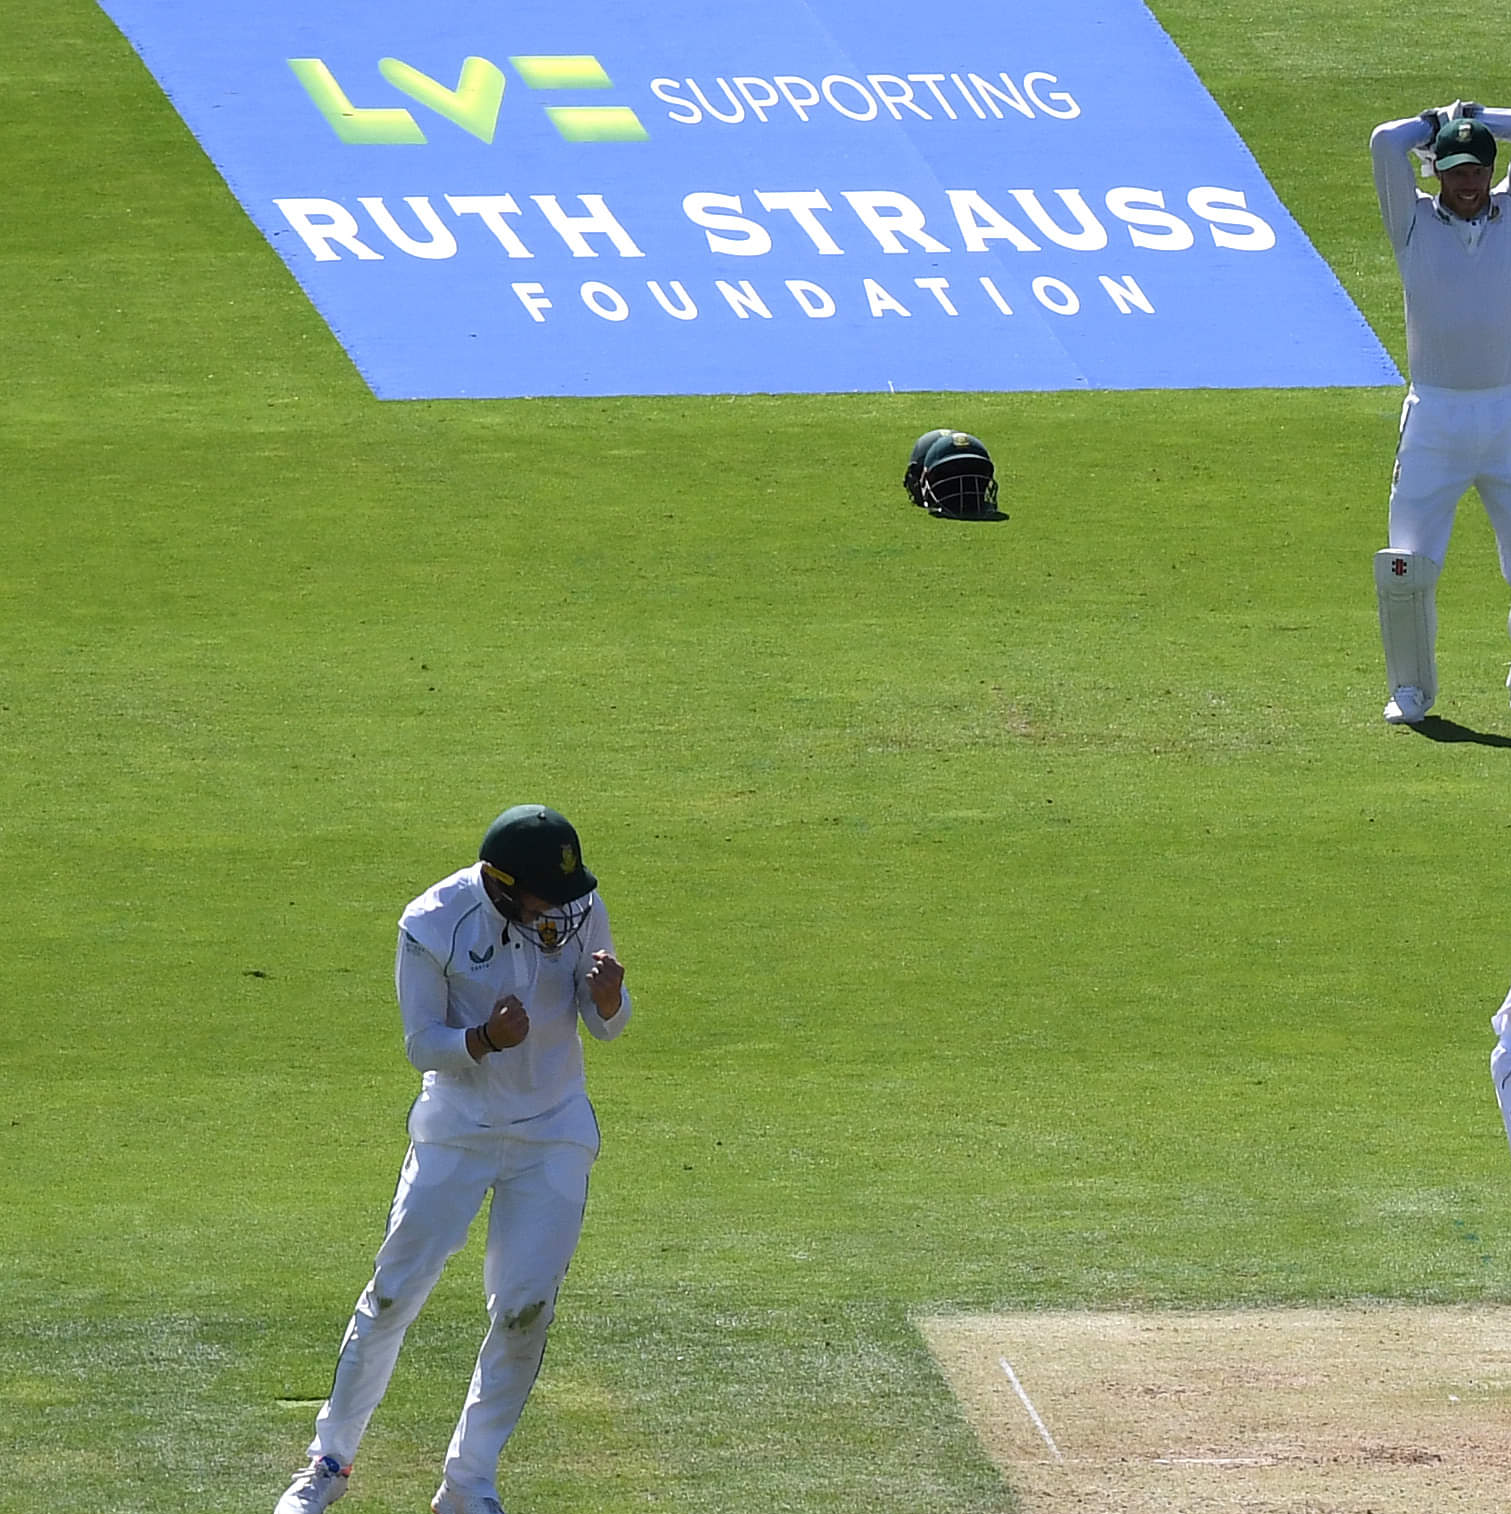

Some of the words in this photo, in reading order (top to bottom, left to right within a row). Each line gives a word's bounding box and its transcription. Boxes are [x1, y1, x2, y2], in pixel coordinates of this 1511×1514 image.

[650, 72, 1081, 124] SUPPORTING
[272, 193, 646, 261] RUTH
[682, 187, 1276, 256] STRAUSS
[511, 275, 1156, 322] FOUNDATION
